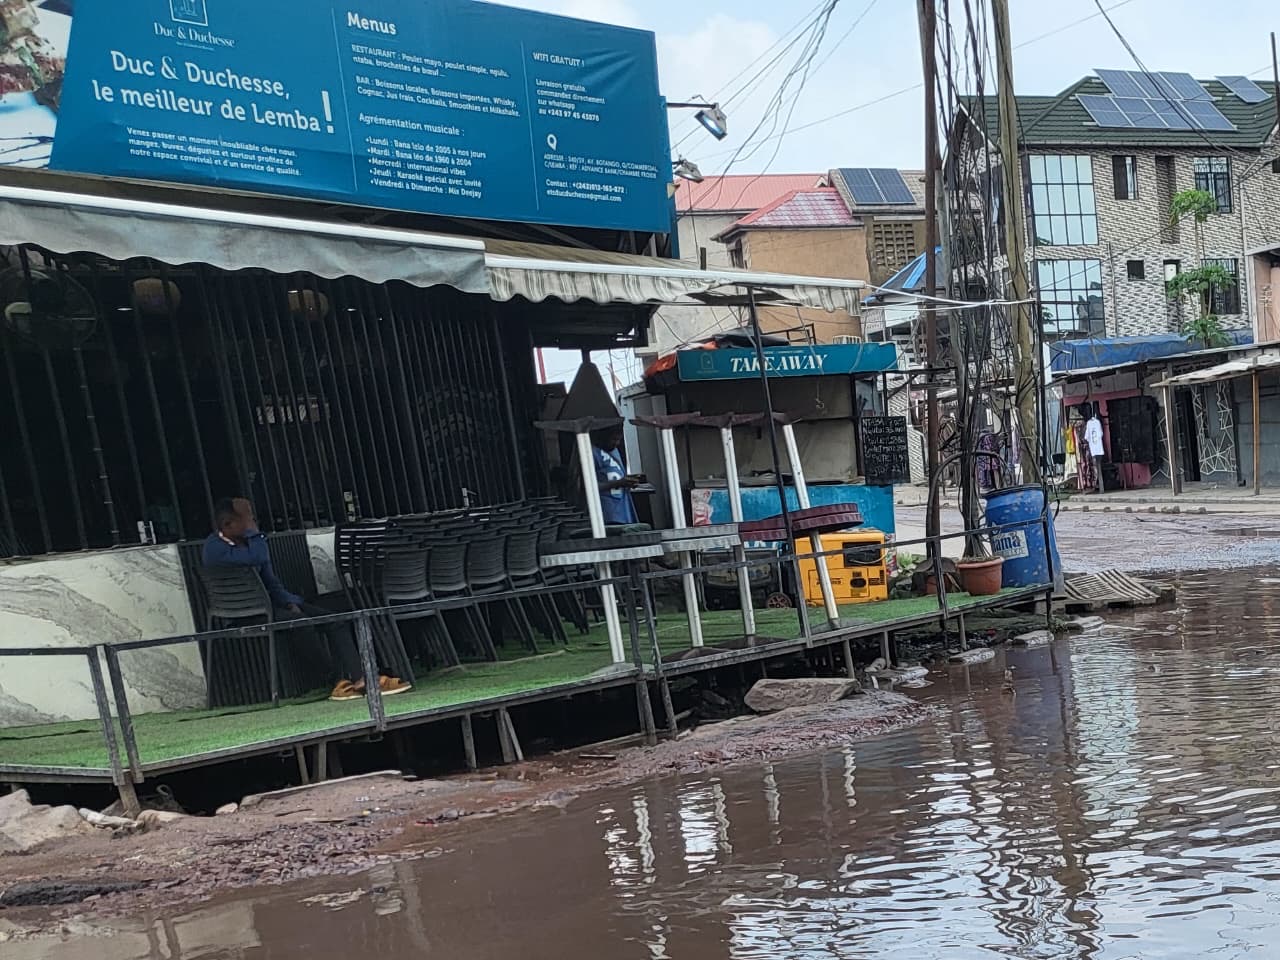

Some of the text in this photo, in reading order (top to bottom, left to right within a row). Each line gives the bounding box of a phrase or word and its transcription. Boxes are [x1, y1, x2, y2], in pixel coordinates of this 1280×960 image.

[347, 11, 397, 35] Menus
[154, 22, 175, 37] Duc
[178, 26, 186, 39] &
[189, 28, 235, 48] Duchesse
[352, 44, 397, 58] RESTAURANT
[550, 55, 581, 67] GRATUIT
[111, 50, 290, 100] Duc & Duchesse,
[536, 78, 562, 89] Livraison
[356, 75, 369, 84] BAR
[375, 79, 404, 90] Boissons
[431, 88, 458, 98] Boissons
[92, 80, 334, 134] le meilleur de Lemba !
[387, 91, 397, 99] Jus
[449, 100, 481, 111] Smoothies
[360, 112, 422, 130] Agrémentation
[424, 124, 460, 136] musicale
[189, 137, 218, 146] moment
[261, 146, 277, 154] chez
[394, 140, 411, 149] Bana
[425, 144, 434, 152] de
[470, 150, 486, 158] jours
[130, 148, 151, 157] notre
[180, 155, 213, 164] convivial
[240, 162, 265, 171] service
[230, 151, 256, 161] surtout
[396, 150, 412, 159] Bana
[397, 170, 423, 181] Karaoké
[425, 174, 446, 184] spécial
[448, 178, 463, 186] avec
[450, 168, 466, 176] vibes
[411, 182, 443, 193] Dimanche
[460, 188, 482, 199] Deejay
[546, 179, 568, 188] Contact
[730, 354, 828, 372] TAKE AWAY
